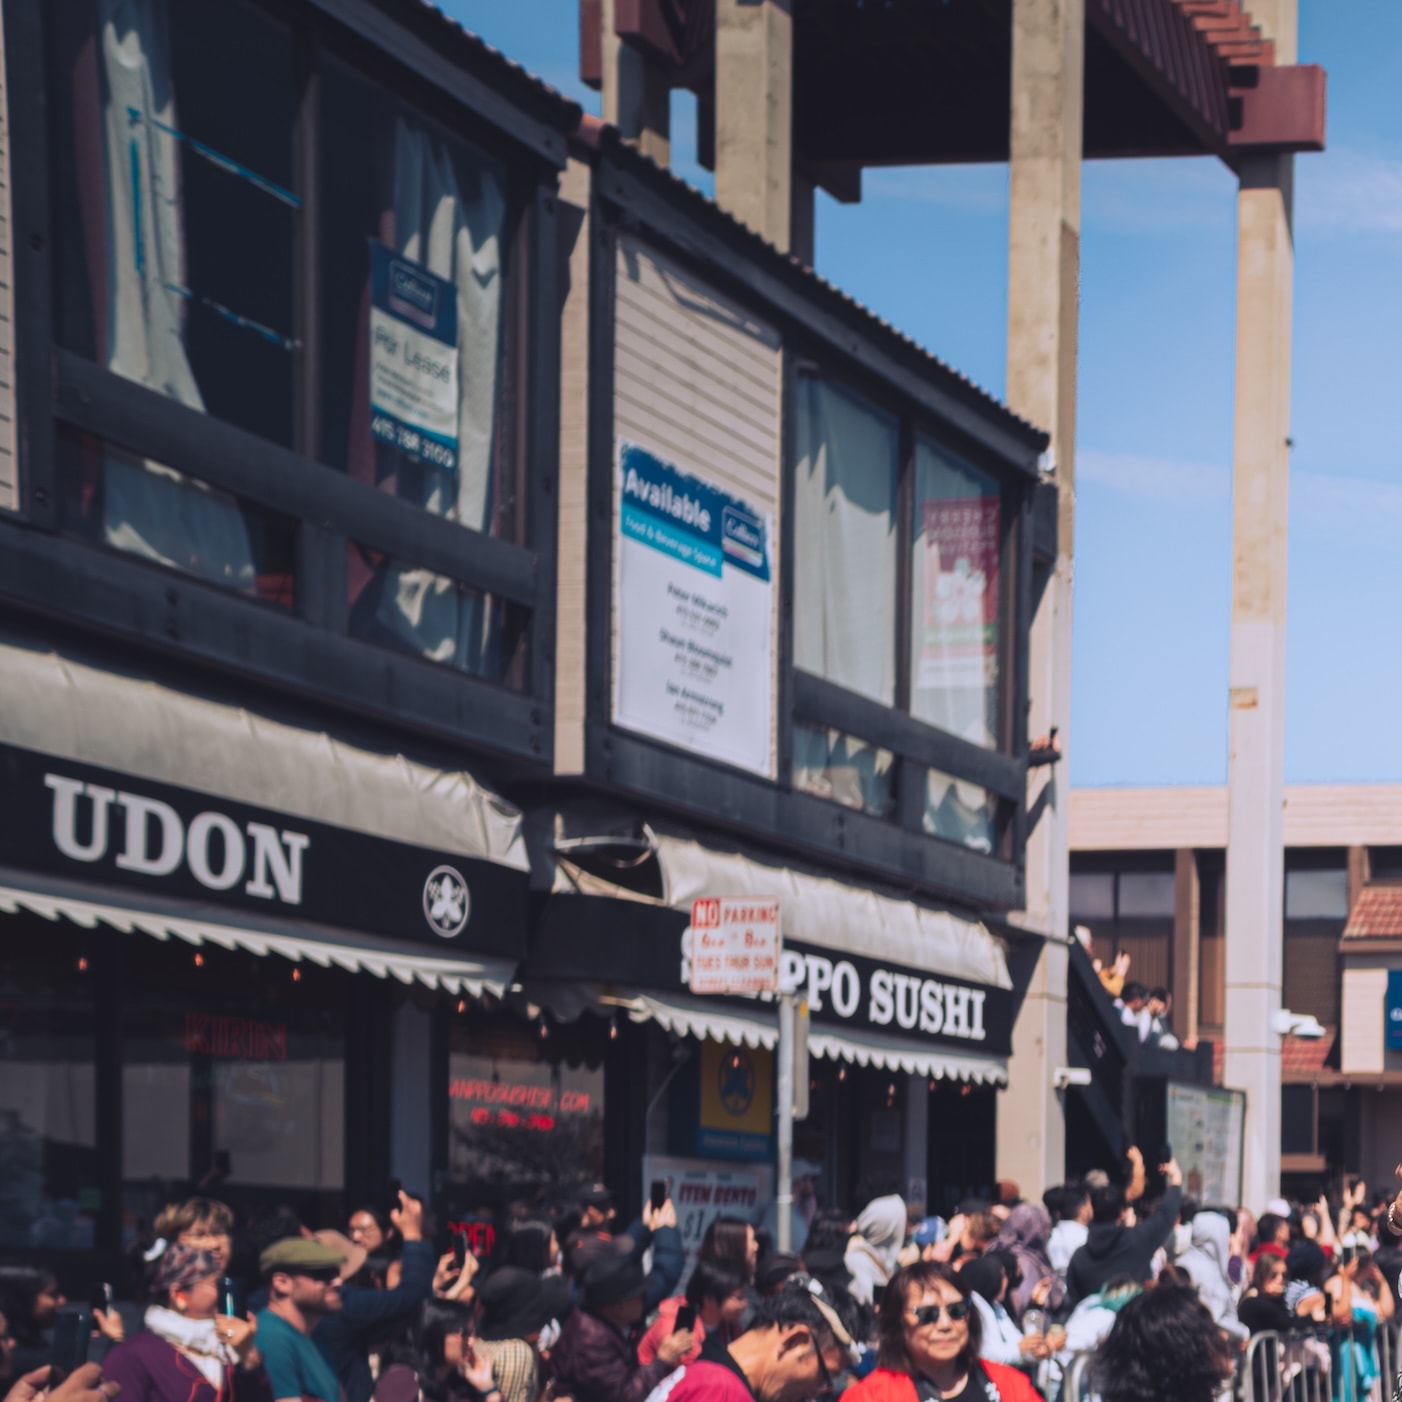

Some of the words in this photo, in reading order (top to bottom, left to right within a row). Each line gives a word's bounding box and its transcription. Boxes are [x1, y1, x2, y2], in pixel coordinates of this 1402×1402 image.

[404, 339, 450, 384] Lease
[625, 467, 711, 532] Available
[655, 529, 692, 558] Beverage
[44, 774, 310, 904] UDON
[696, 901, 719, 927] NO
[723, 906, 776, 924] PARKING
[869, 969, 986, 1041] SUSHI
